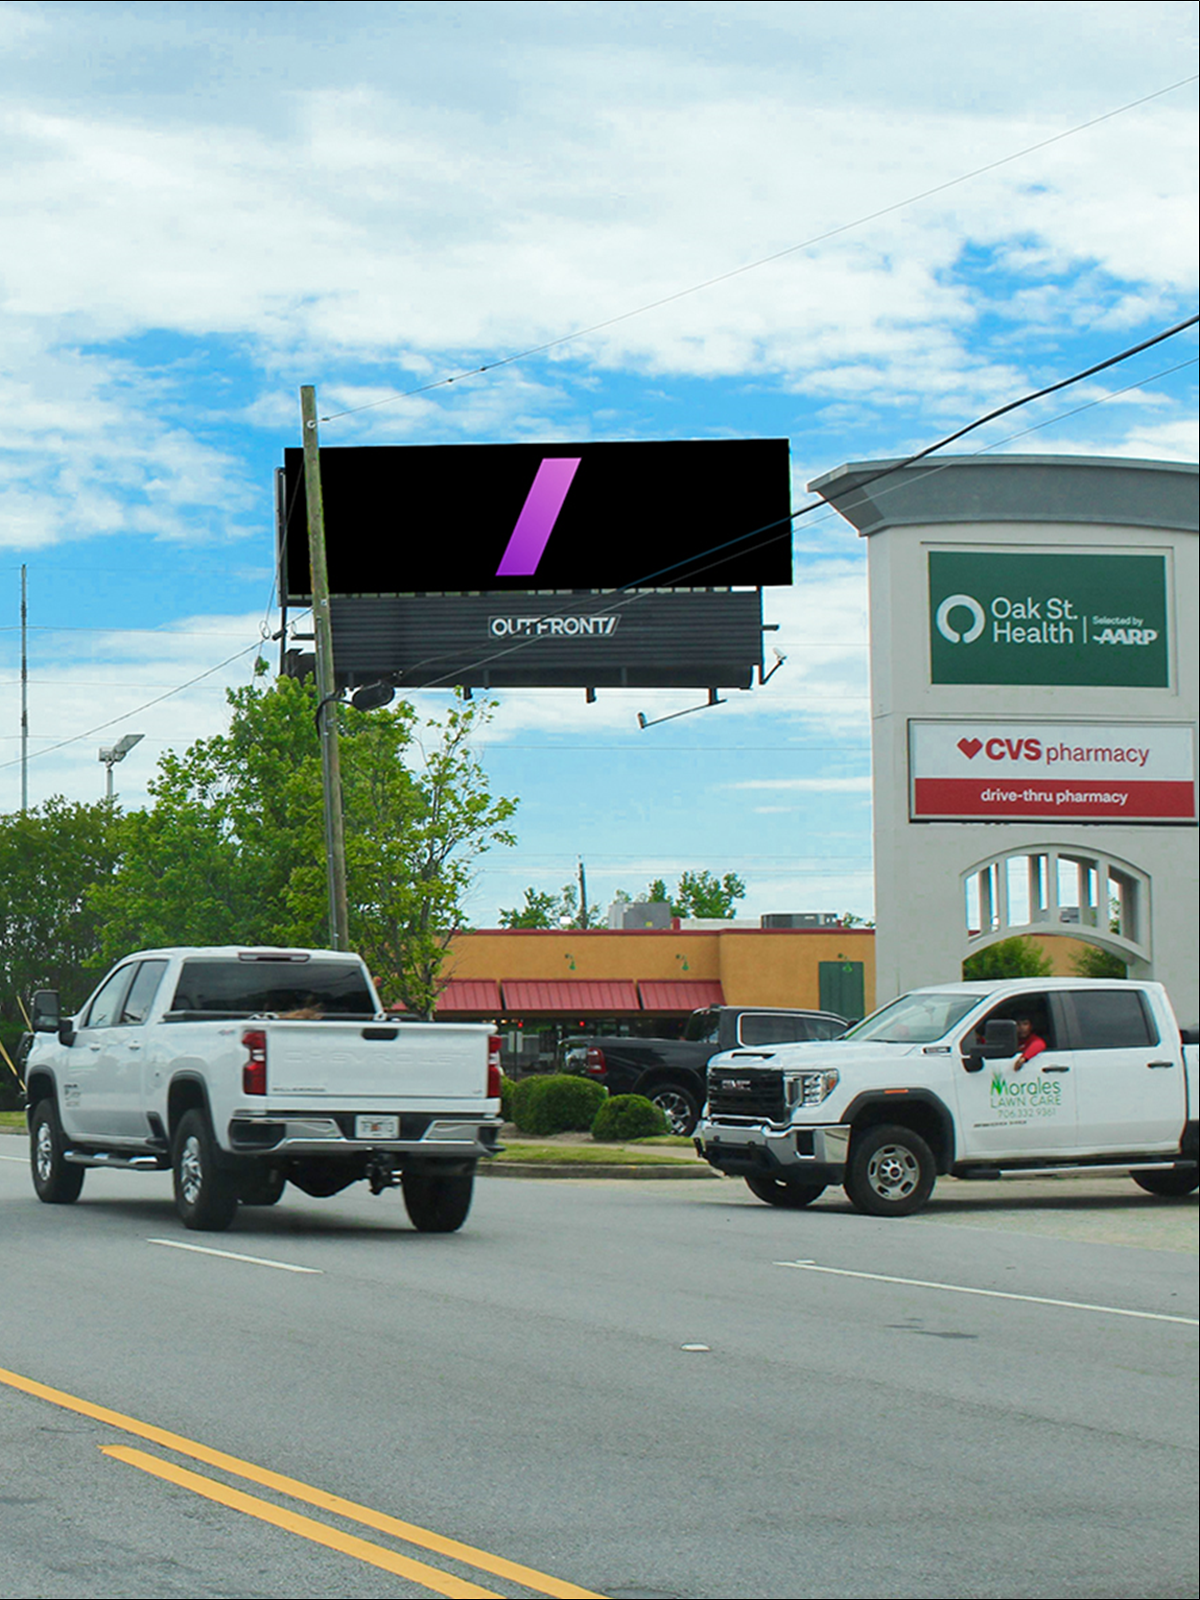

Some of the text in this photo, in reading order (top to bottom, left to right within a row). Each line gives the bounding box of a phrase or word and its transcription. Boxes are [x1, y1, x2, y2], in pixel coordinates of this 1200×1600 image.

[991, 597, 1078, 620] Oak St.
[1093, 615, 1144, 627] Selected by
[993, 621, 1074, 644] Health
[1093, 629, 1158, 645] AARP
[985, 738, 1150, 767] CVS pharmacy
[980, 788, 1128, 806] drive-thru pharmacy
[990, 1073, 1061, 1096] Morales
[990, 1094, 1062, 1109] LAWN CARE
